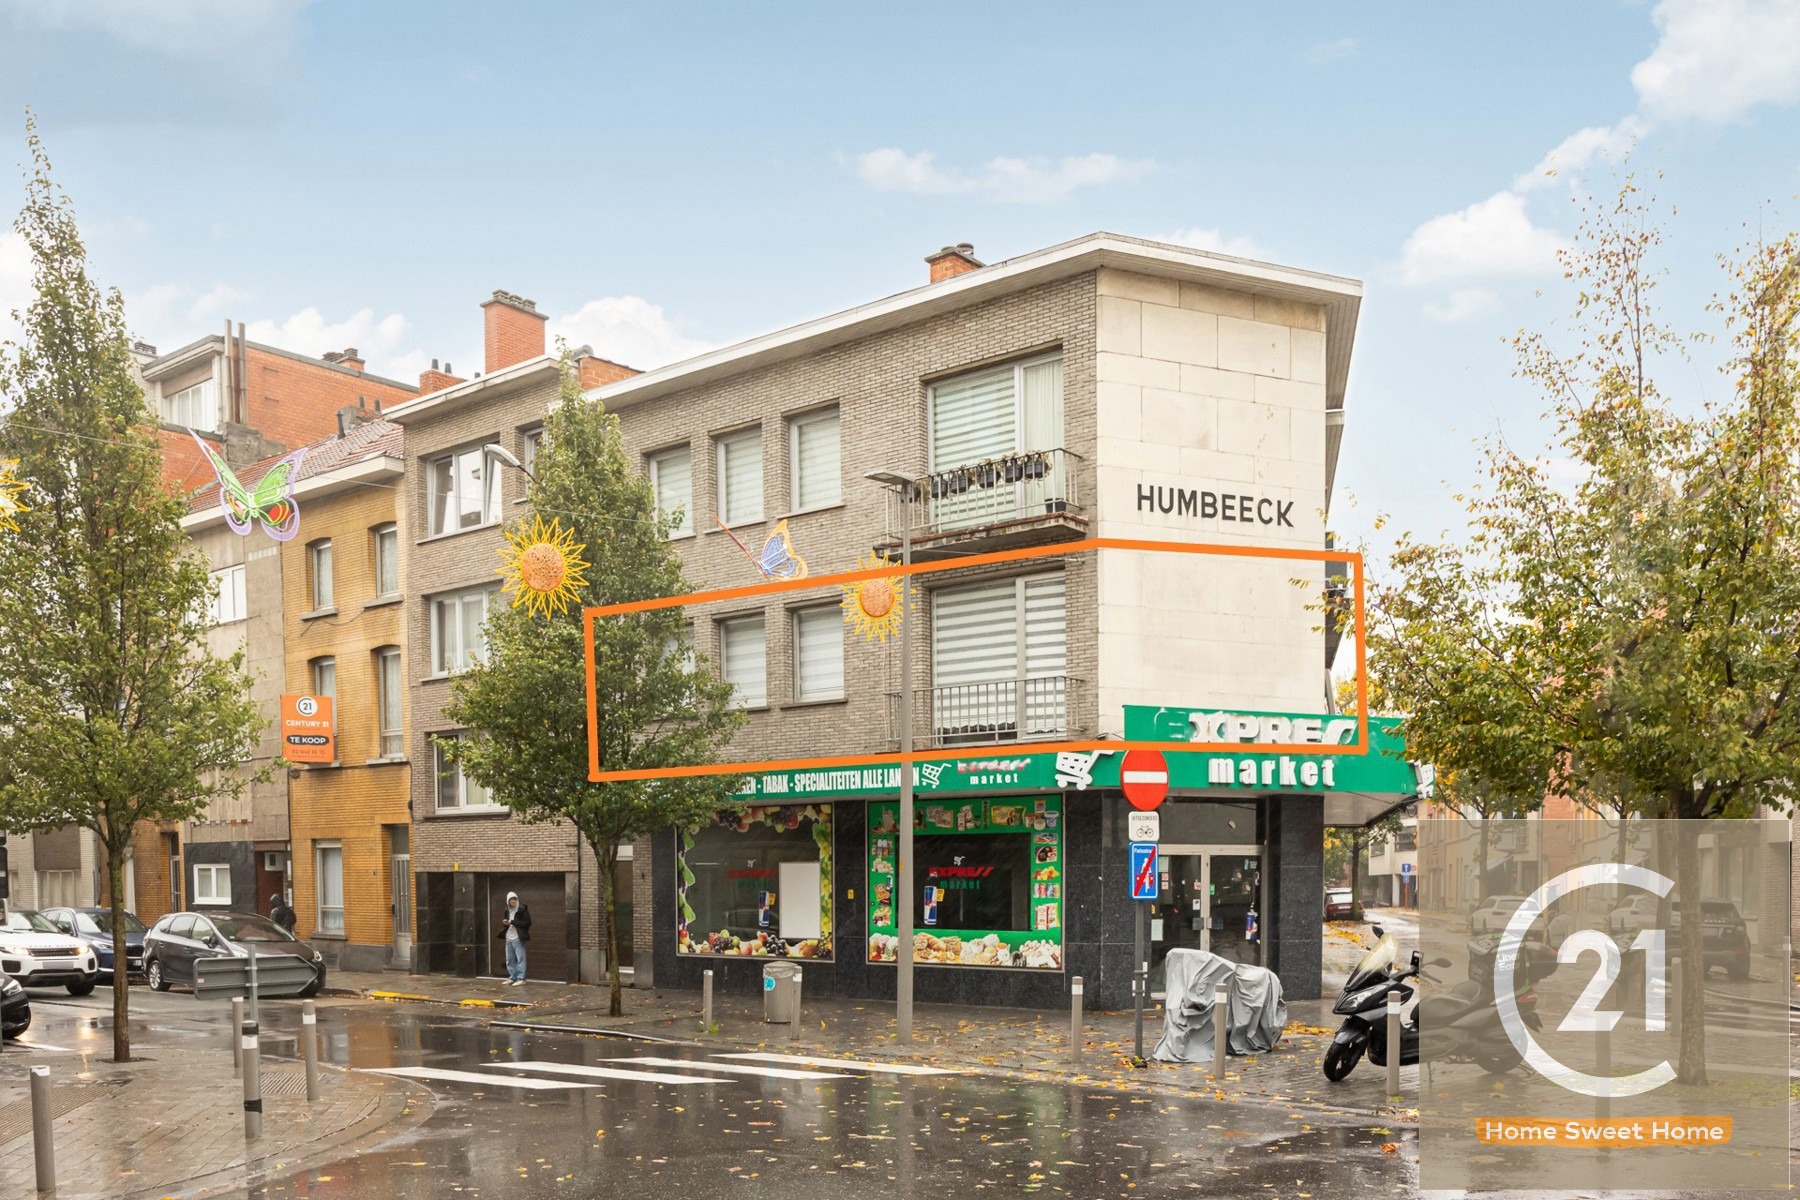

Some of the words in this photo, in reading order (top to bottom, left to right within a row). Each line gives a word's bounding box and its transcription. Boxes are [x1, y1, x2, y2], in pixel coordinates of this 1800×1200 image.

[1137, 483, 1294, 528] HUMBEECK
[290, 736, 300, 744] TE
[763, 774, 789, 793] TABAK
[794, 770, 861, 792] SPECIALITEITEN
[862, 768, 883, 789] ALLE
[884, 766, 920, 787] LANN
[970, 773, 1019, 785] market
[1208, 756, 1335, 787] market
[929, 866, 994, 878] EXPRESS
